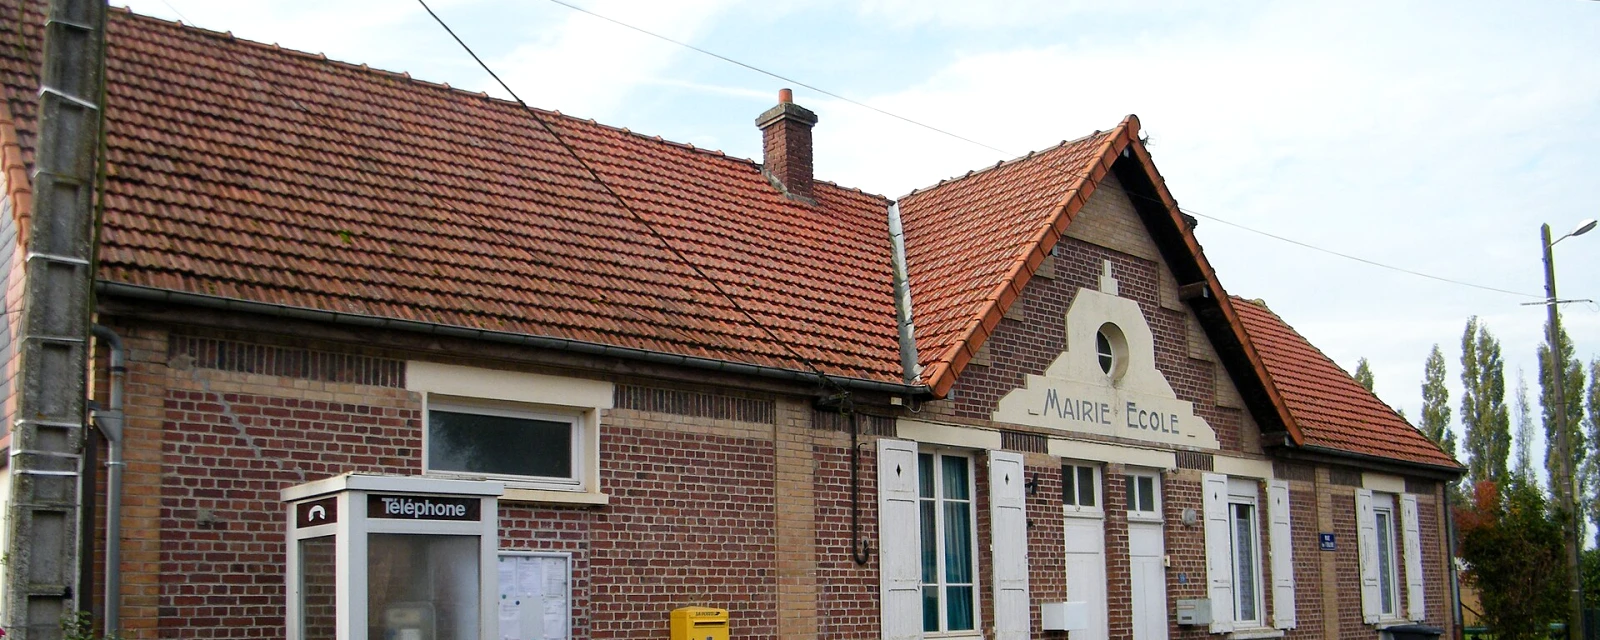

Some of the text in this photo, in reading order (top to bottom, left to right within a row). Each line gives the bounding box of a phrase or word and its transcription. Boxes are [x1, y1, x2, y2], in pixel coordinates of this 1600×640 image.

[1043, 388, 1180, 435] MAIRIE ECOLE
[381, 497, 466, 518] Téléphone
